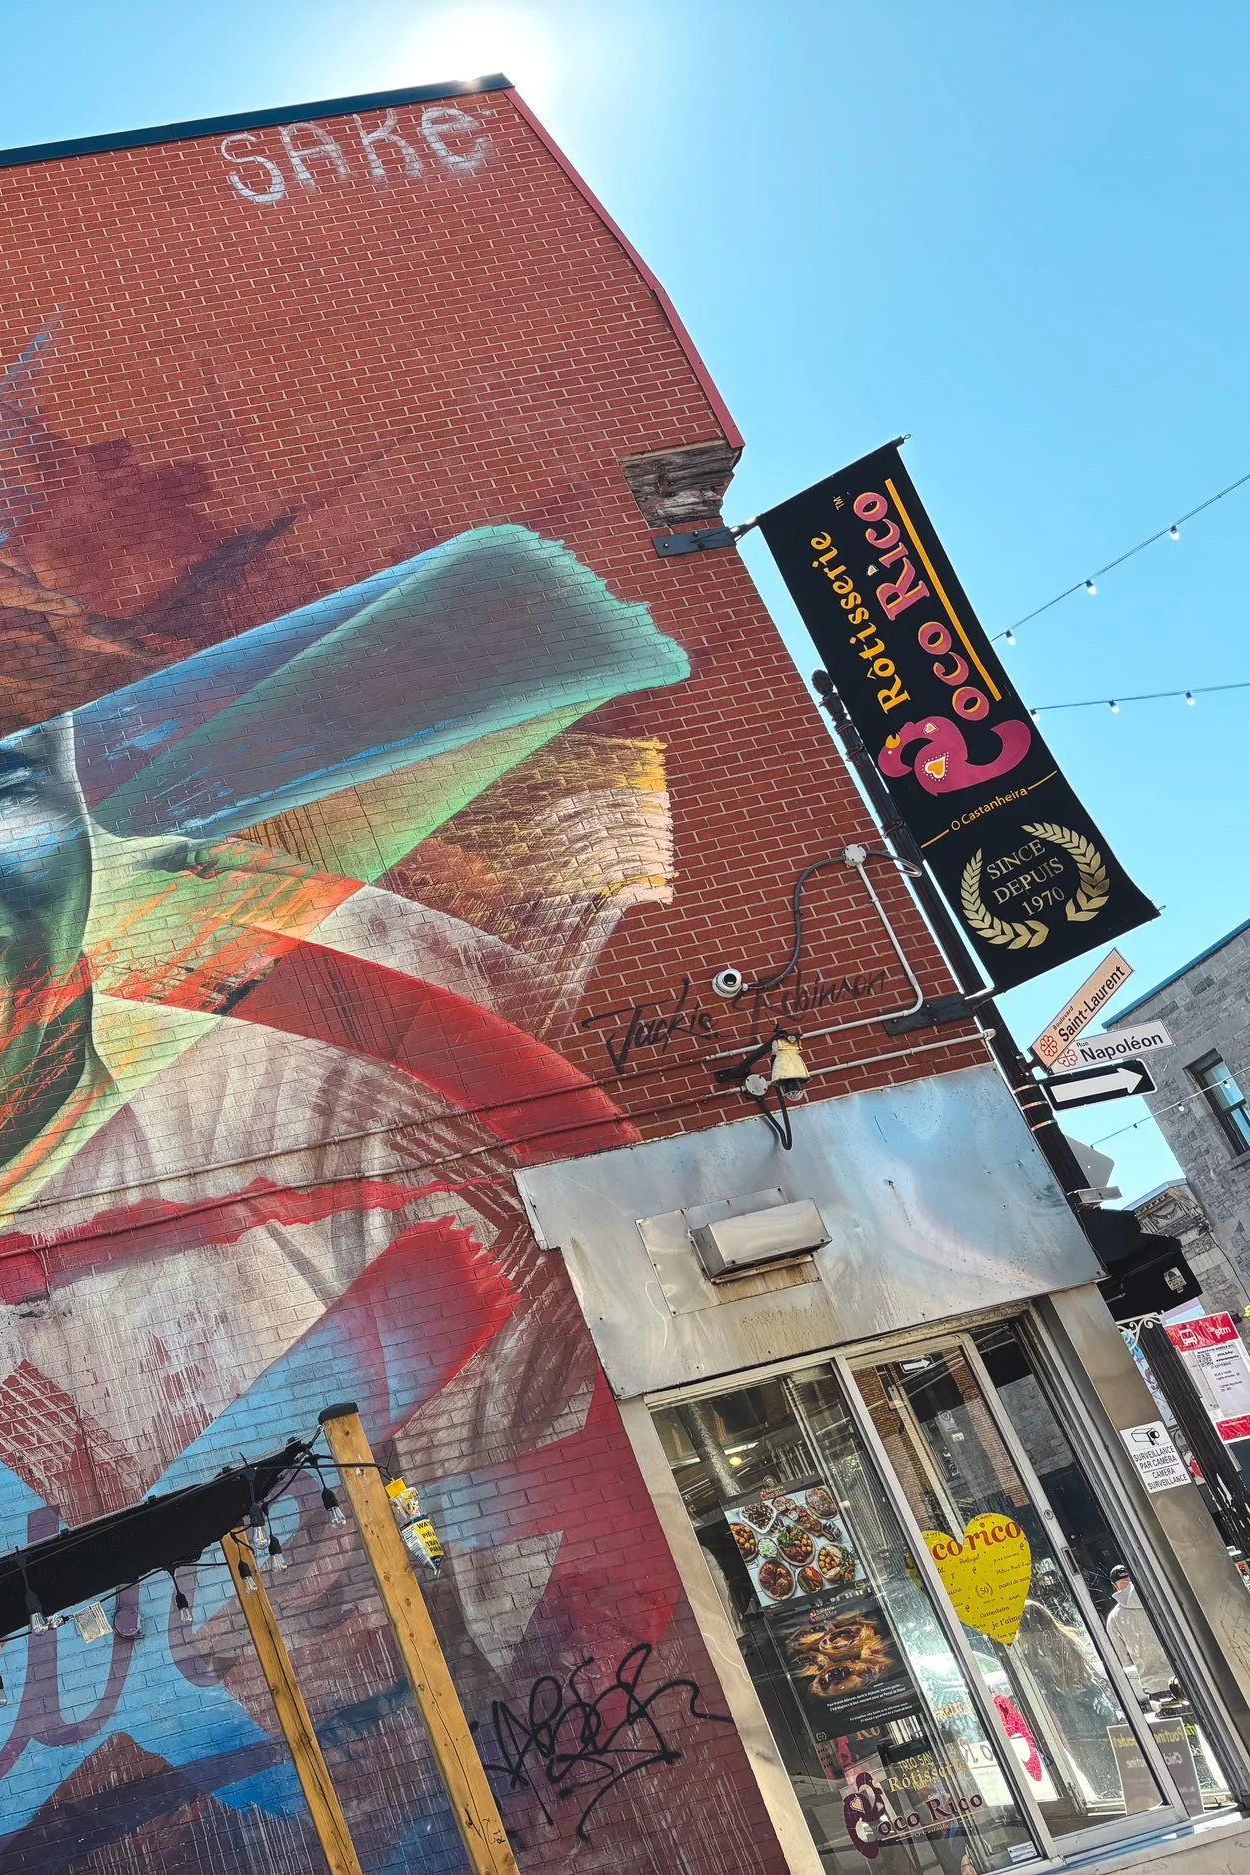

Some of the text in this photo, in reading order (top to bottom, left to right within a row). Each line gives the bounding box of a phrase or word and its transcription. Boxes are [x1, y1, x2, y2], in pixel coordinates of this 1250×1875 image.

[853, 491, 931, 621] Rico
[810, 531, 911, 714] Rôtisserie
[950, 786, 1029, 832] O Castanheira
[986, 839, 1046, 881] SINCE
[992, 857, 1065, 905] DEPUIS
[1021, 886, 1065, 917] 1970
[1052, 1005, 1075, 1031] Boulevard
[1058, 965, 1126, 1042] Saint-Laurent
[1076, 1040, 1090, 1049] Rue
[1081, 1033, 1164, 1062] Napoléon
[1214, 1326, 1232, 1337] stm
[1133, 1445, 1176, 1462] SURVEILLANCE
[1139, 1459, 1153, 1470] PAR
[1147, 1474, 1189, 1490] SURVEILLANCE
[1152, 1466, 1177, 1479] CAMERA
[965, 1522, 1023, 1551] rico
[888, 1759, 968, 1793] Rôtisserie
[898, 1756, 917, 1772] TRIO
[925, 1793, 983, 1821] Rico
